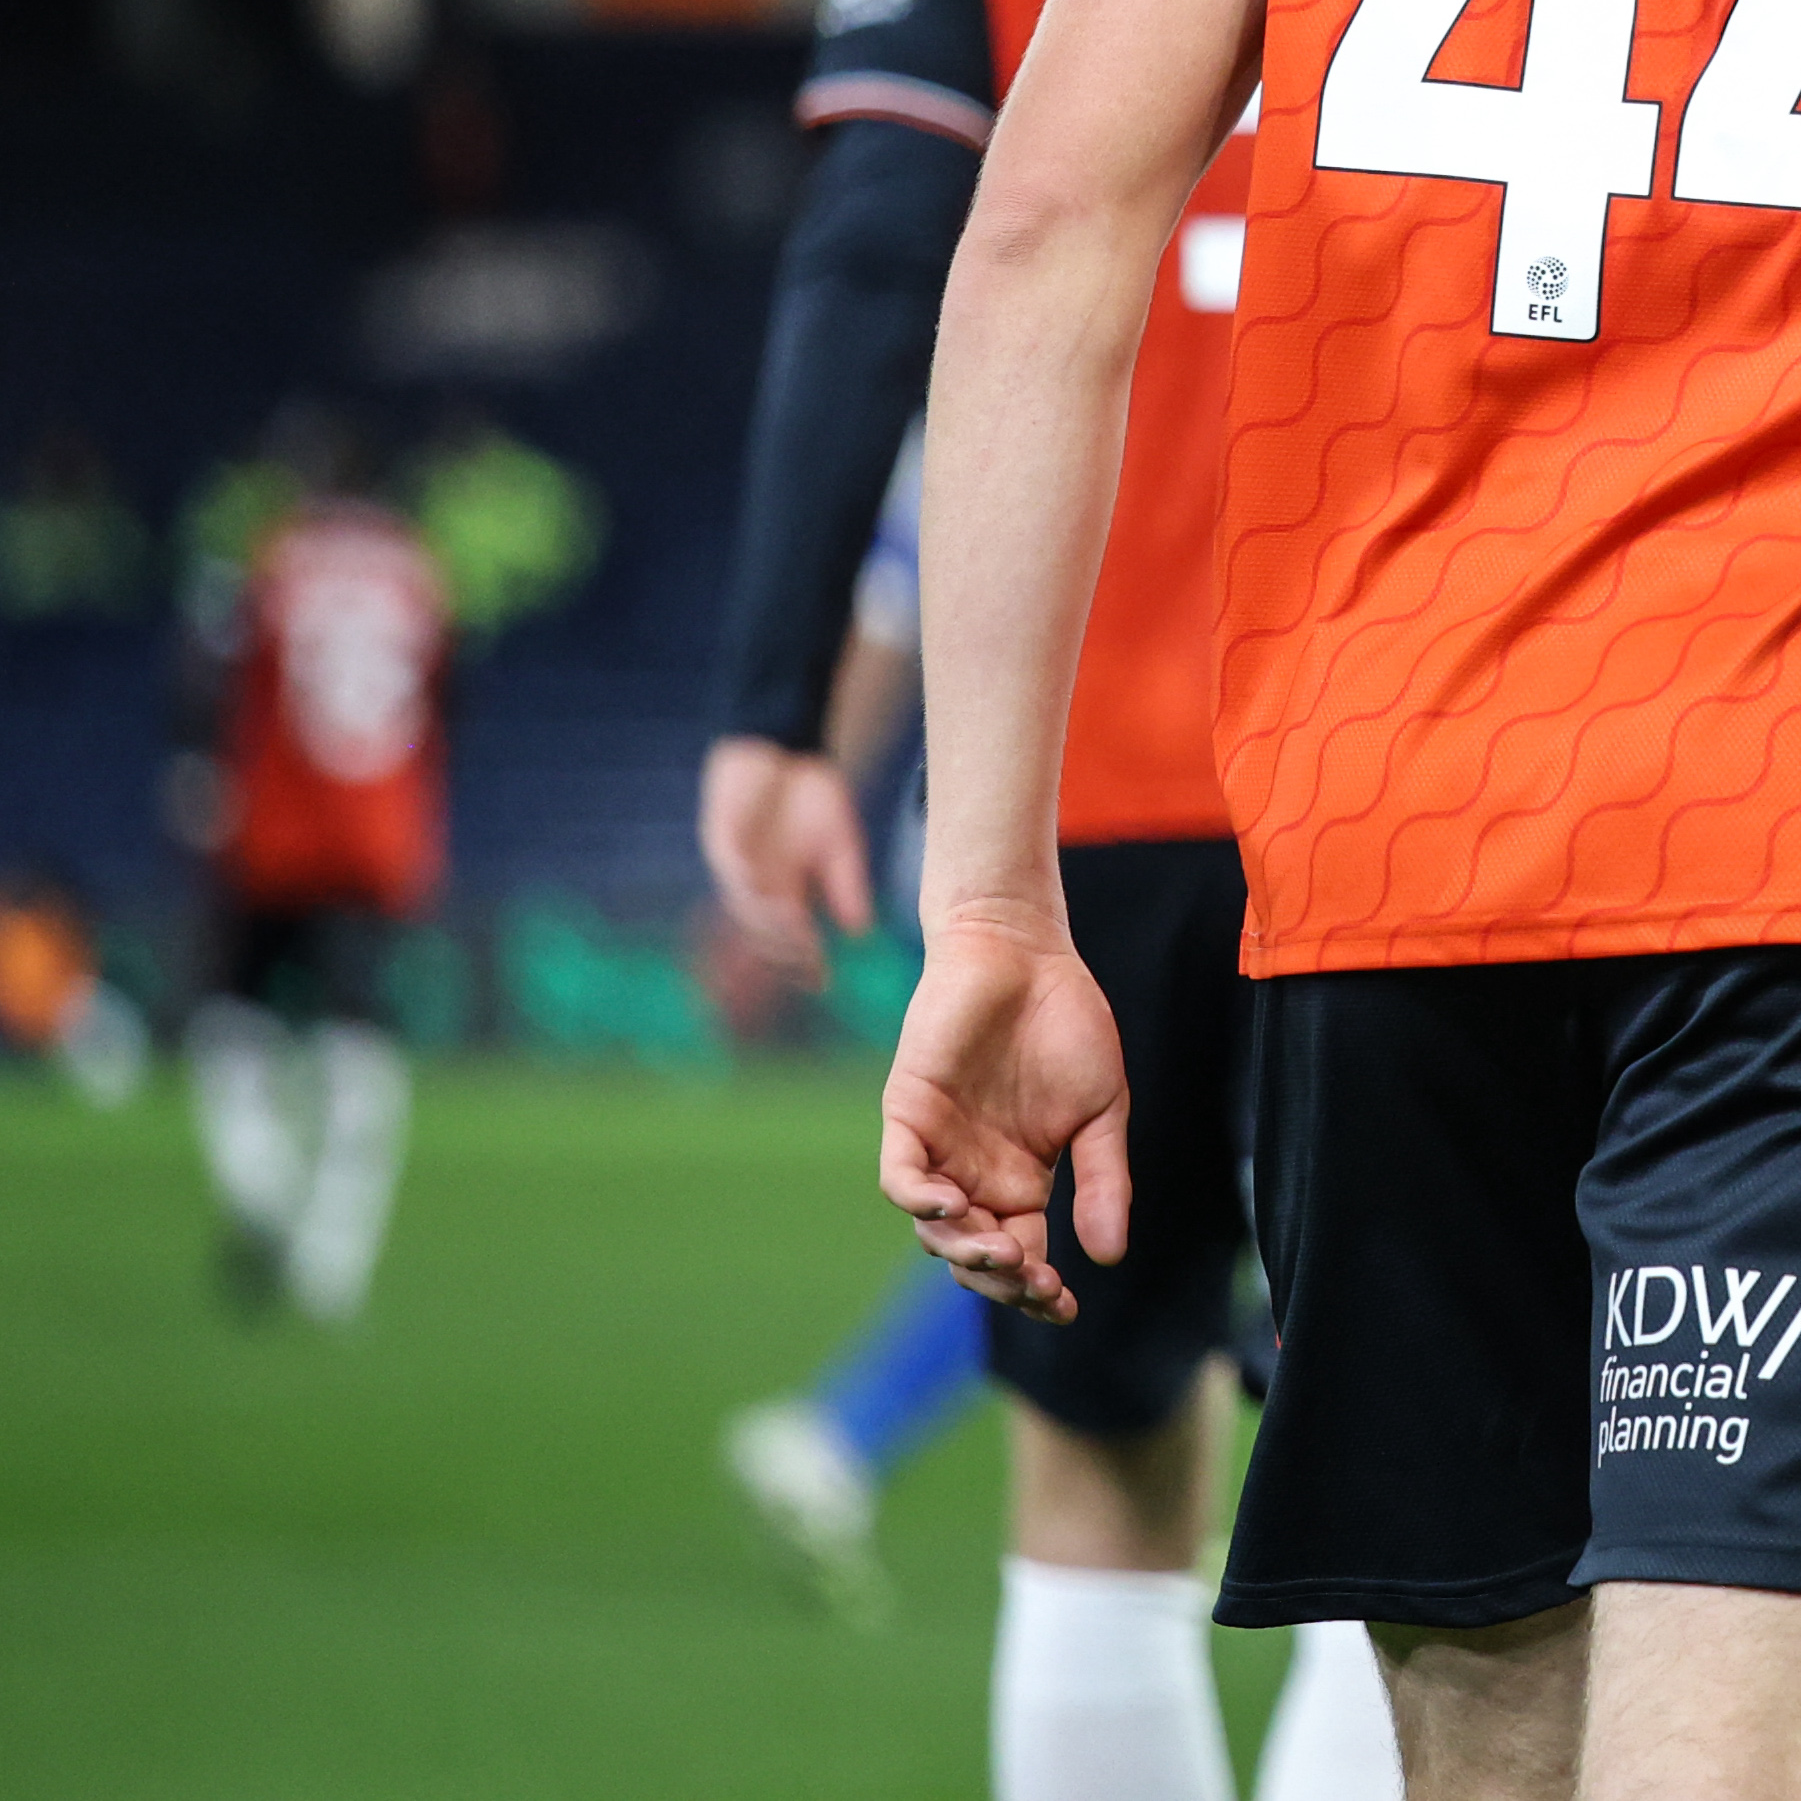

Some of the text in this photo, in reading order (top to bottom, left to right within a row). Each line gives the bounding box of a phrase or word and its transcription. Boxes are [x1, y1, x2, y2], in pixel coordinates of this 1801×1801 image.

[1528, 303, 1563, 324] EFL
[1600, 1350, 1751, 1404] financial
[1597, 1402, 1750, 1468] planning
